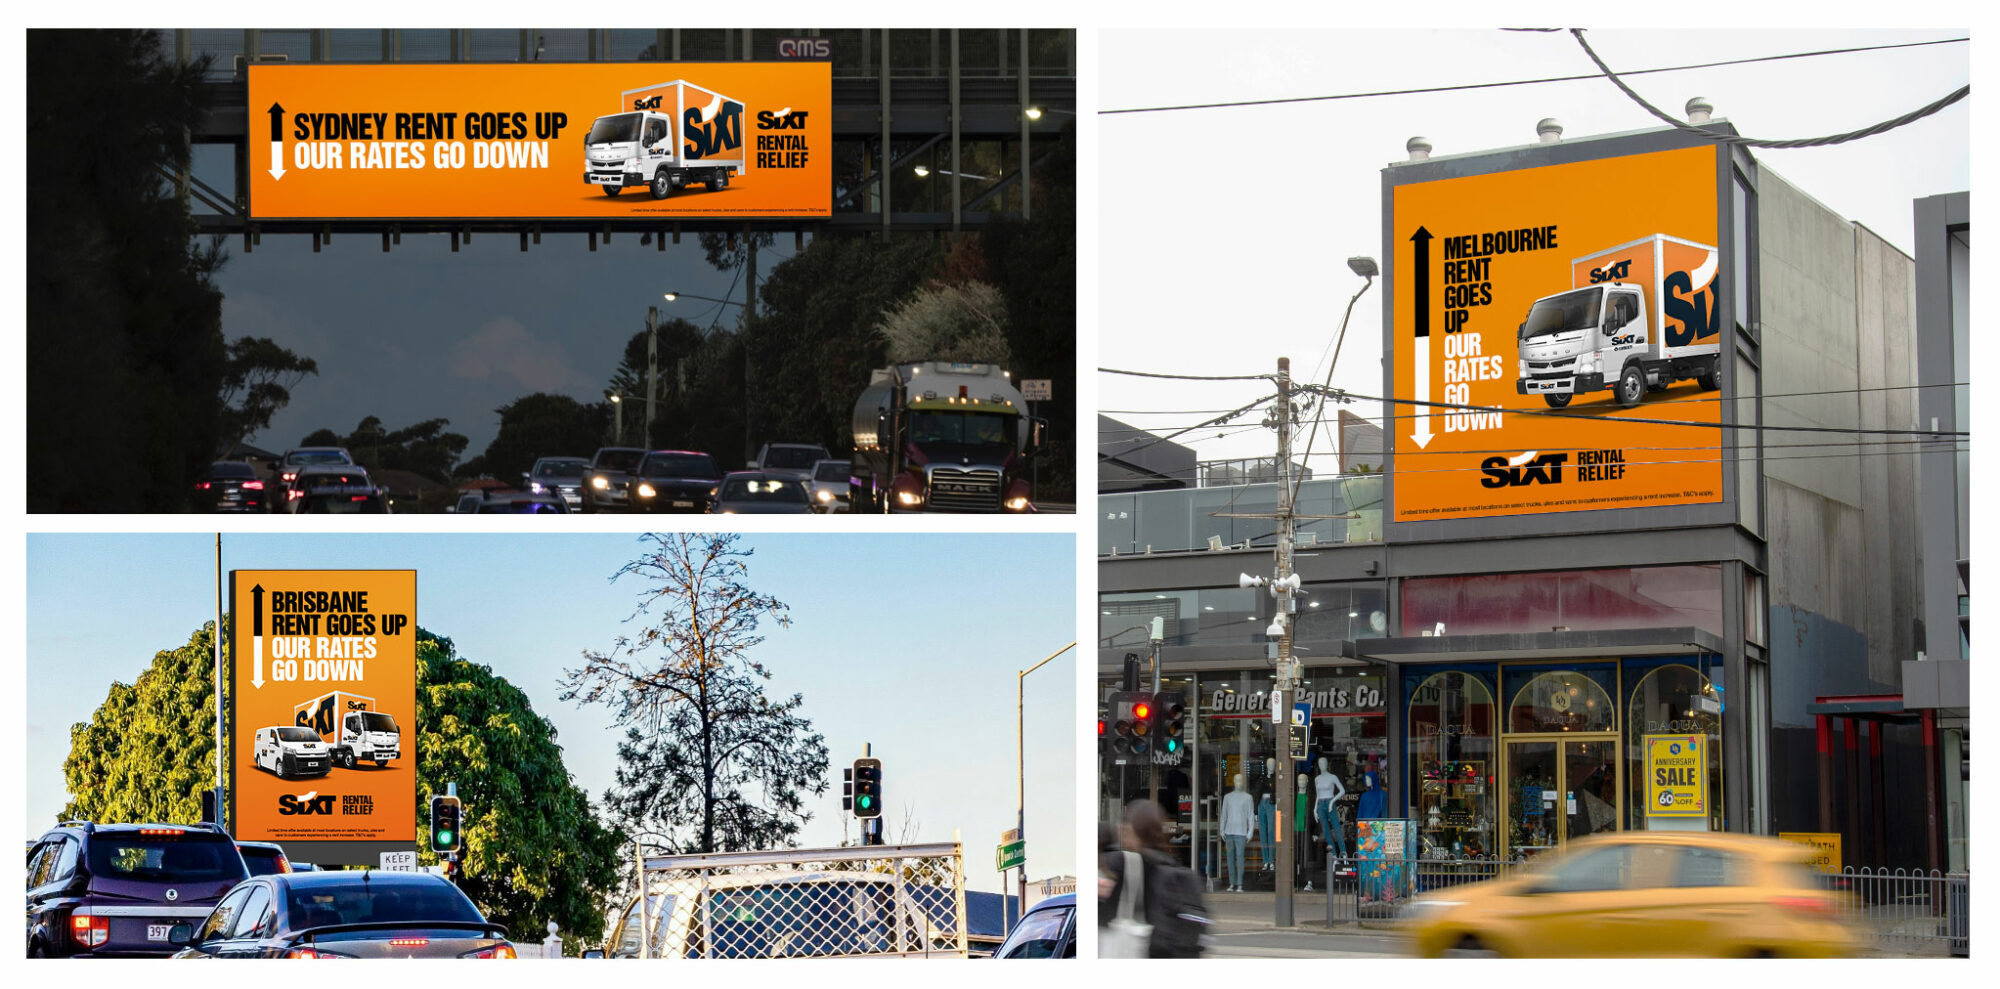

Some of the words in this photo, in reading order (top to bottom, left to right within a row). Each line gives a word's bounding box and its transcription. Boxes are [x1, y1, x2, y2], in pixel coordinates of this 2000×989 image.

[294, 112, 387, 141] SYDNEY
[396, 112, 458, 140] RENT
[465, 112, 527, 140] GOES
[536, 112, 567, 139] UP
[757, 135, 808, 150] RENTAL
[294, 141, 342, 170] OUR
[349, 141, 426, 169] RATES
[433, 141, 466, 169] GO
[473, 141, 549, 169] DOWN
[757, 152, 808, 168] RELIEF
[1444, 225, 1558, 261] MELBOURNE
[1444, 257, 1492, 286] RENT
[1444, 281, 1492, 311] GOES
[1444, 309, 1469, 334] UP
[1444, 332, 1482, 358] OUR
[1444, 355, 1503, 384] RATES
[1444, 383, 1470, 407] GO
[1444, 405, 1503, 433] DOWN
[1578, 449, 1626, 466] RENTAL
[1578, 464, 1626, 482] RELIEF
[937, 484, 993, 492] MACK
[272, 591, 368, 613] BRISBANE
[272, 614, 321, 635] RENT
[327, 614, 376, 635] GOES
[382, 614, 407, 635] UP
[272, 637, 311, 658] OUR
[317, 637, 377, 658] RATES
[272, 659, 298, 681] GO
[304, 659, 363, 681] DOWN
[1294, 687, 1347, 708] Pants
[1356, 685, 1385, 707] Co.
[1427, 724, 1476, 738] DAQUA
[1649, 720, 1703, 732] DAQUA
[1655, 758, 1696, 766] ANNIVERSARY
[1656, 768, 1696, 786] SALE
[343, 794, 373, 805] RENTAL
[1660, 793, 1674, 804] 60
[343, 804, 374, 816] RELIEF
[385, 854, 411, 863] KEEP
[150, 927, 167, 936] 397
